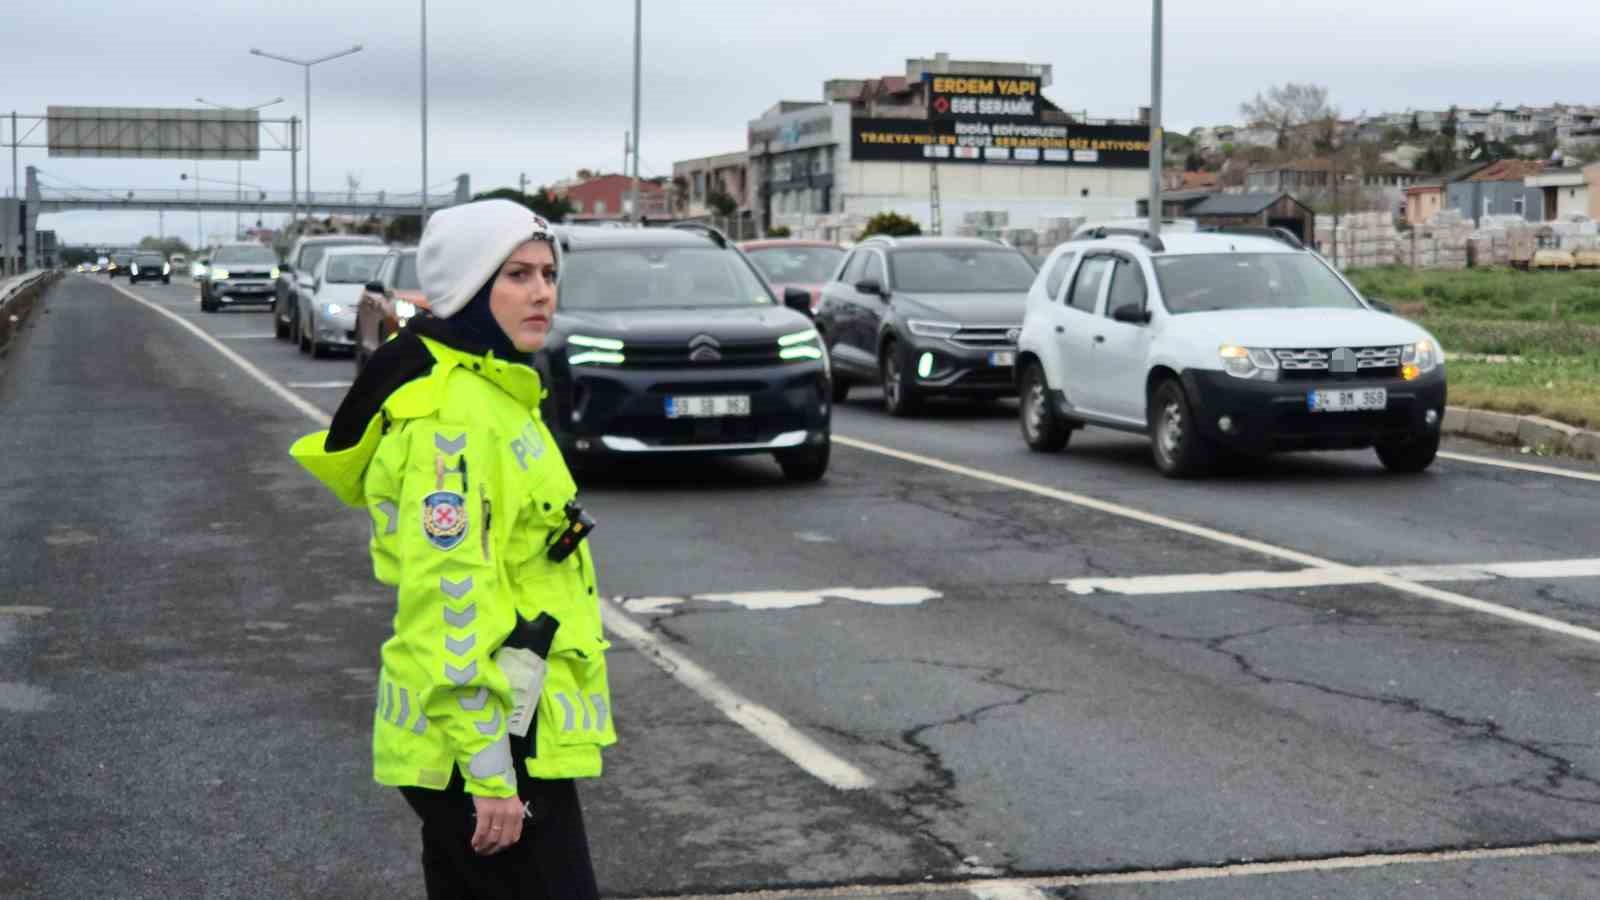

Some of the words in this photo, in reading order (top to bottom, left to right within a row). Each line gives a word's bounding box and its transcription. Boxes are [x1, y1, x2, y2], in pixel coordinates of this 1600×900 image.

[933, 79, 993, 94] ERDEM
[997, 80, 1036, 95] YAPI
[950, 97, 976, 113] EGE
[979, 96, 1034, 115] SERAMİK
[1091, 139, 1152, 151] SATIYORU
